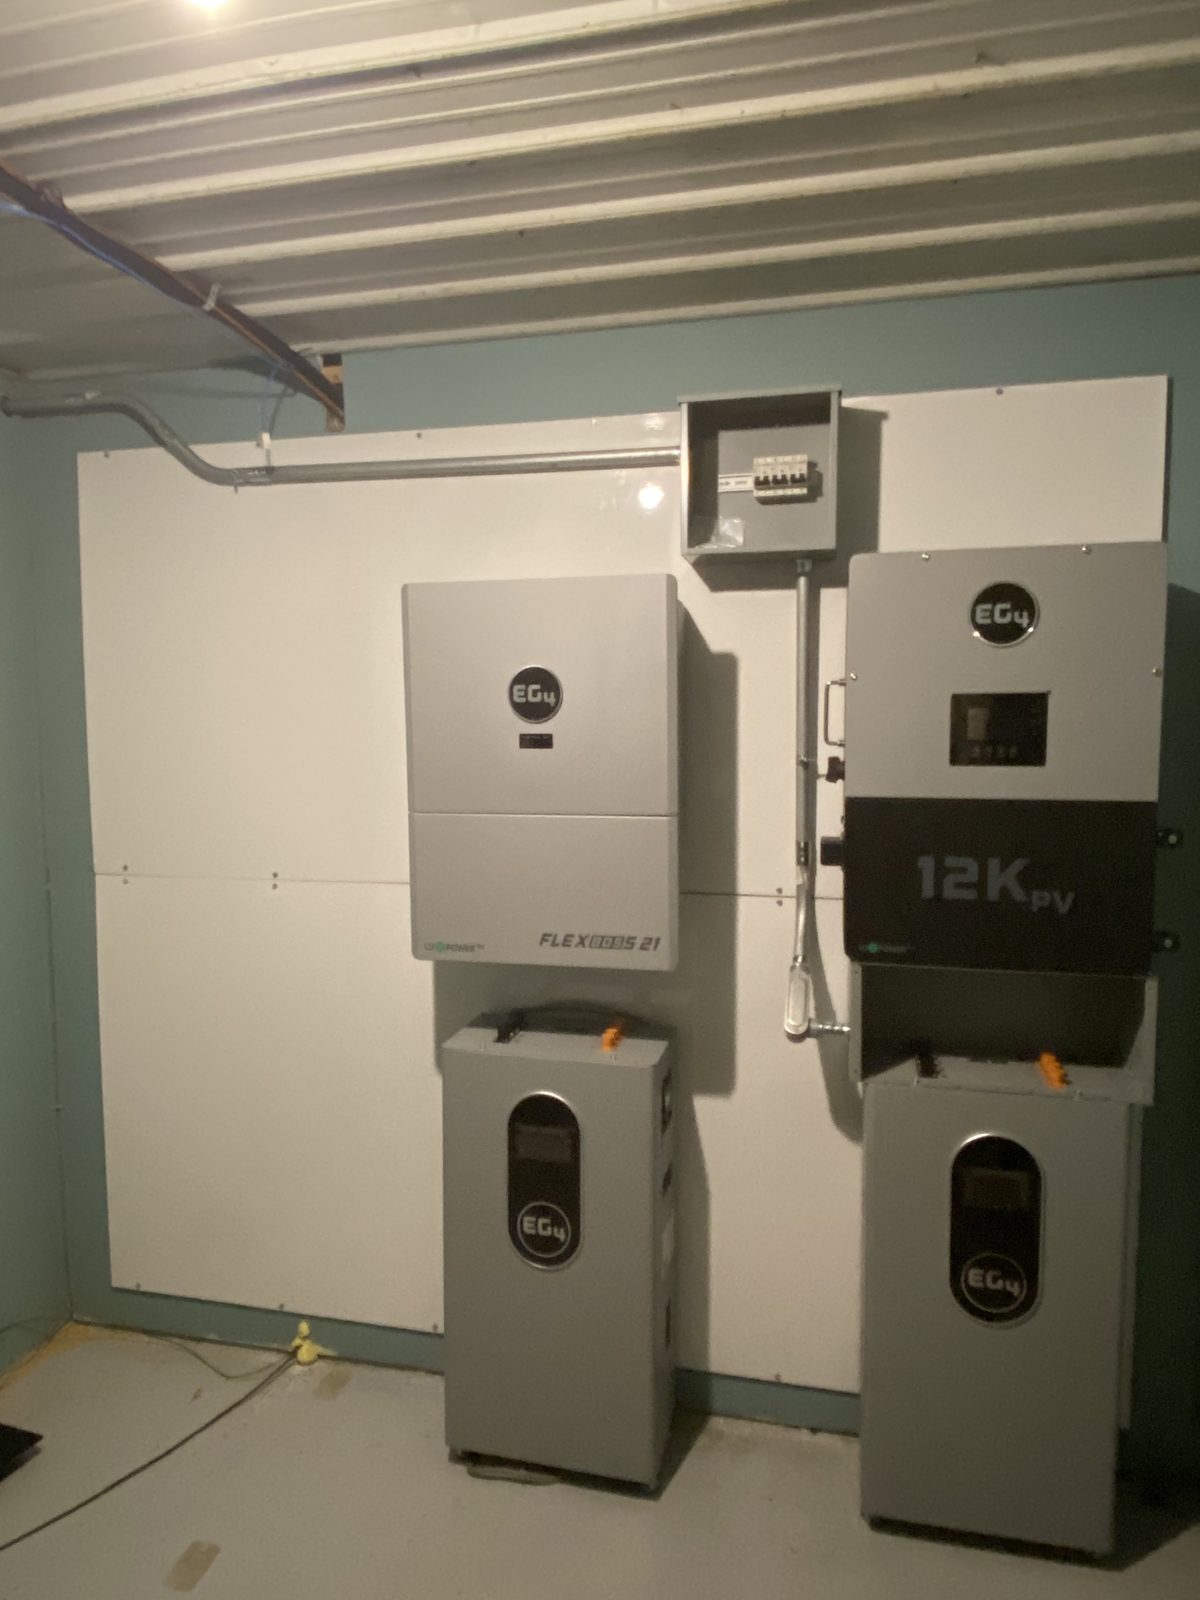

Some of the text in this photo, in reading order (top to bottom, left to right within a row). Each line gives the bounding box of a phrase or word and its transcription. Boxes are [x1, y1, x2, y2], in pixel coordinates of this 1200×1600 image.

[975, 603, 1030, 628] EG4
[512, 684, 556, 707] EG4
[638, 936, 661, 951] 21
[522, 1216, 566, 1243] EG4
[967, 1267, 1021, 1298] EG4
